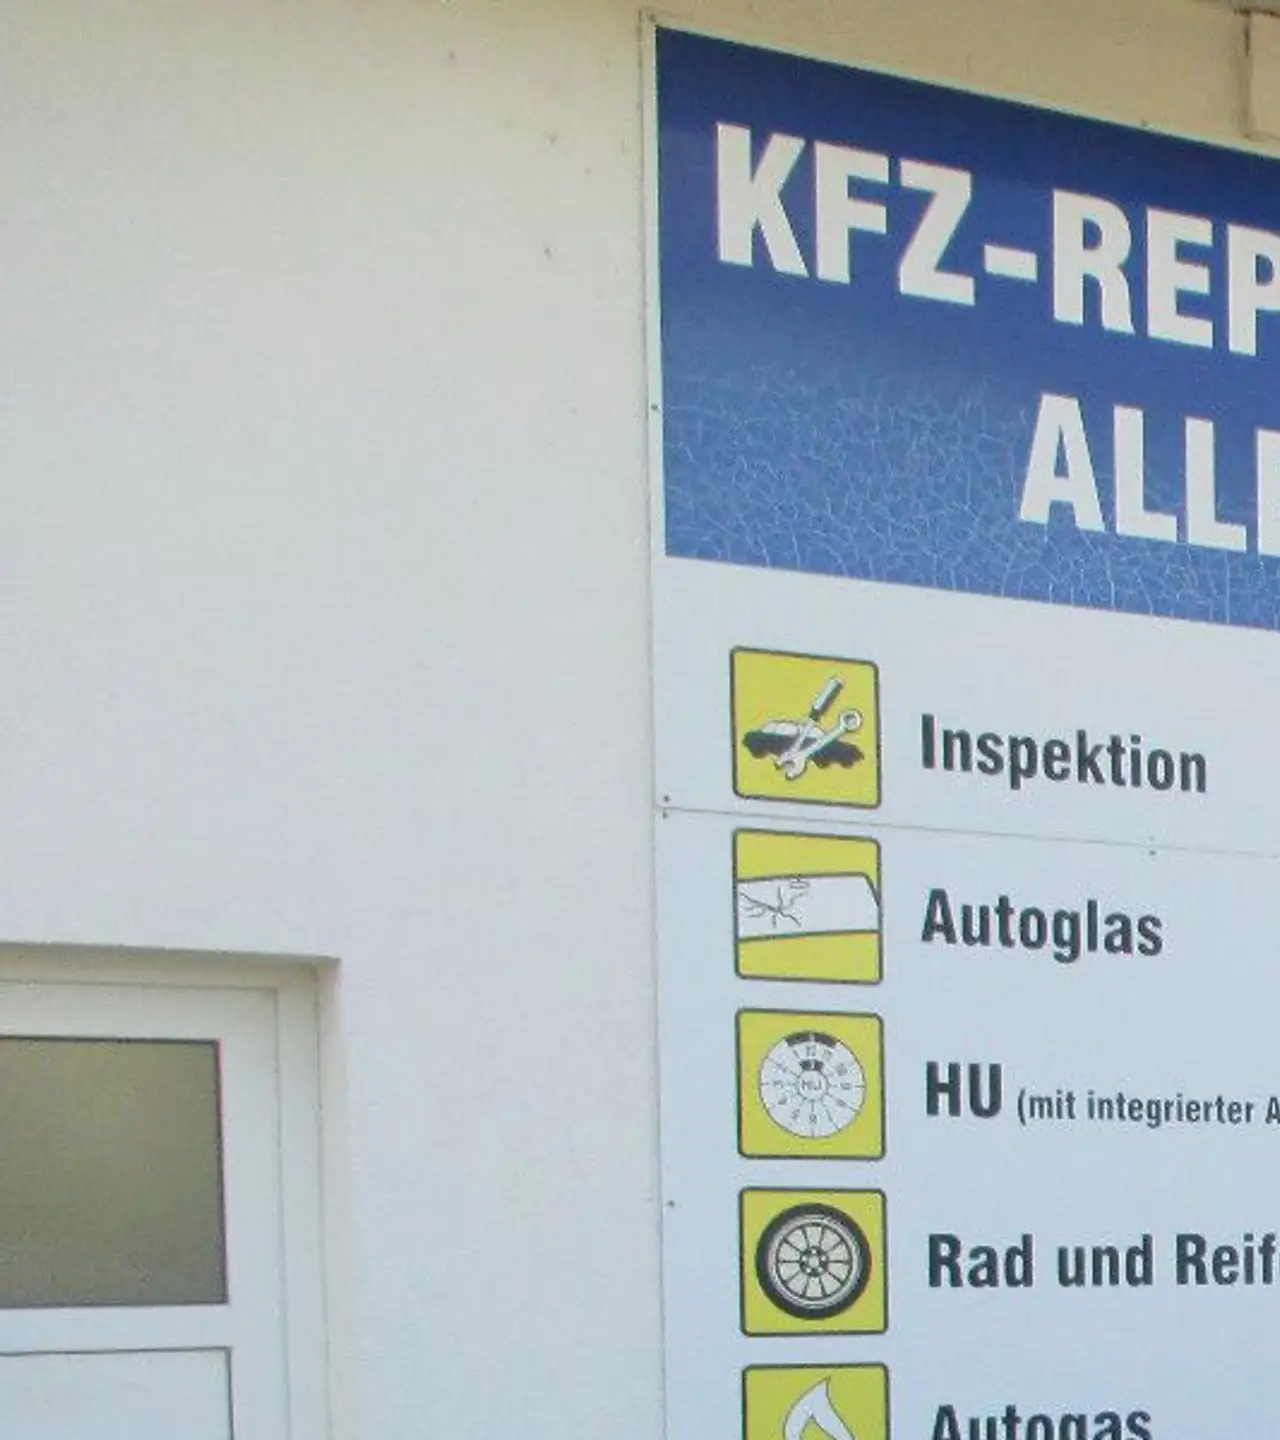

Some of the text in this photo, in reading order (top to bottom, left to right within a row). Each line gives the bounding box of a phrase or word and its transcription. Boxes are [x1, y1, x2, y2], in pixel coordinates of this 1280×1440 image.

[920, 713, 1207, 794] Inspektion
[920, 887, 1165, 964] Autoglas
[925, 1061, 1002, 1118] HU
[1017, 1088, 1077, 1126] (mit
[1087, 1090, 1256, 1129] integrierter
[927, 1233, 1034, 1288] Rad
[1057, 1233, 1153, 1288] und
